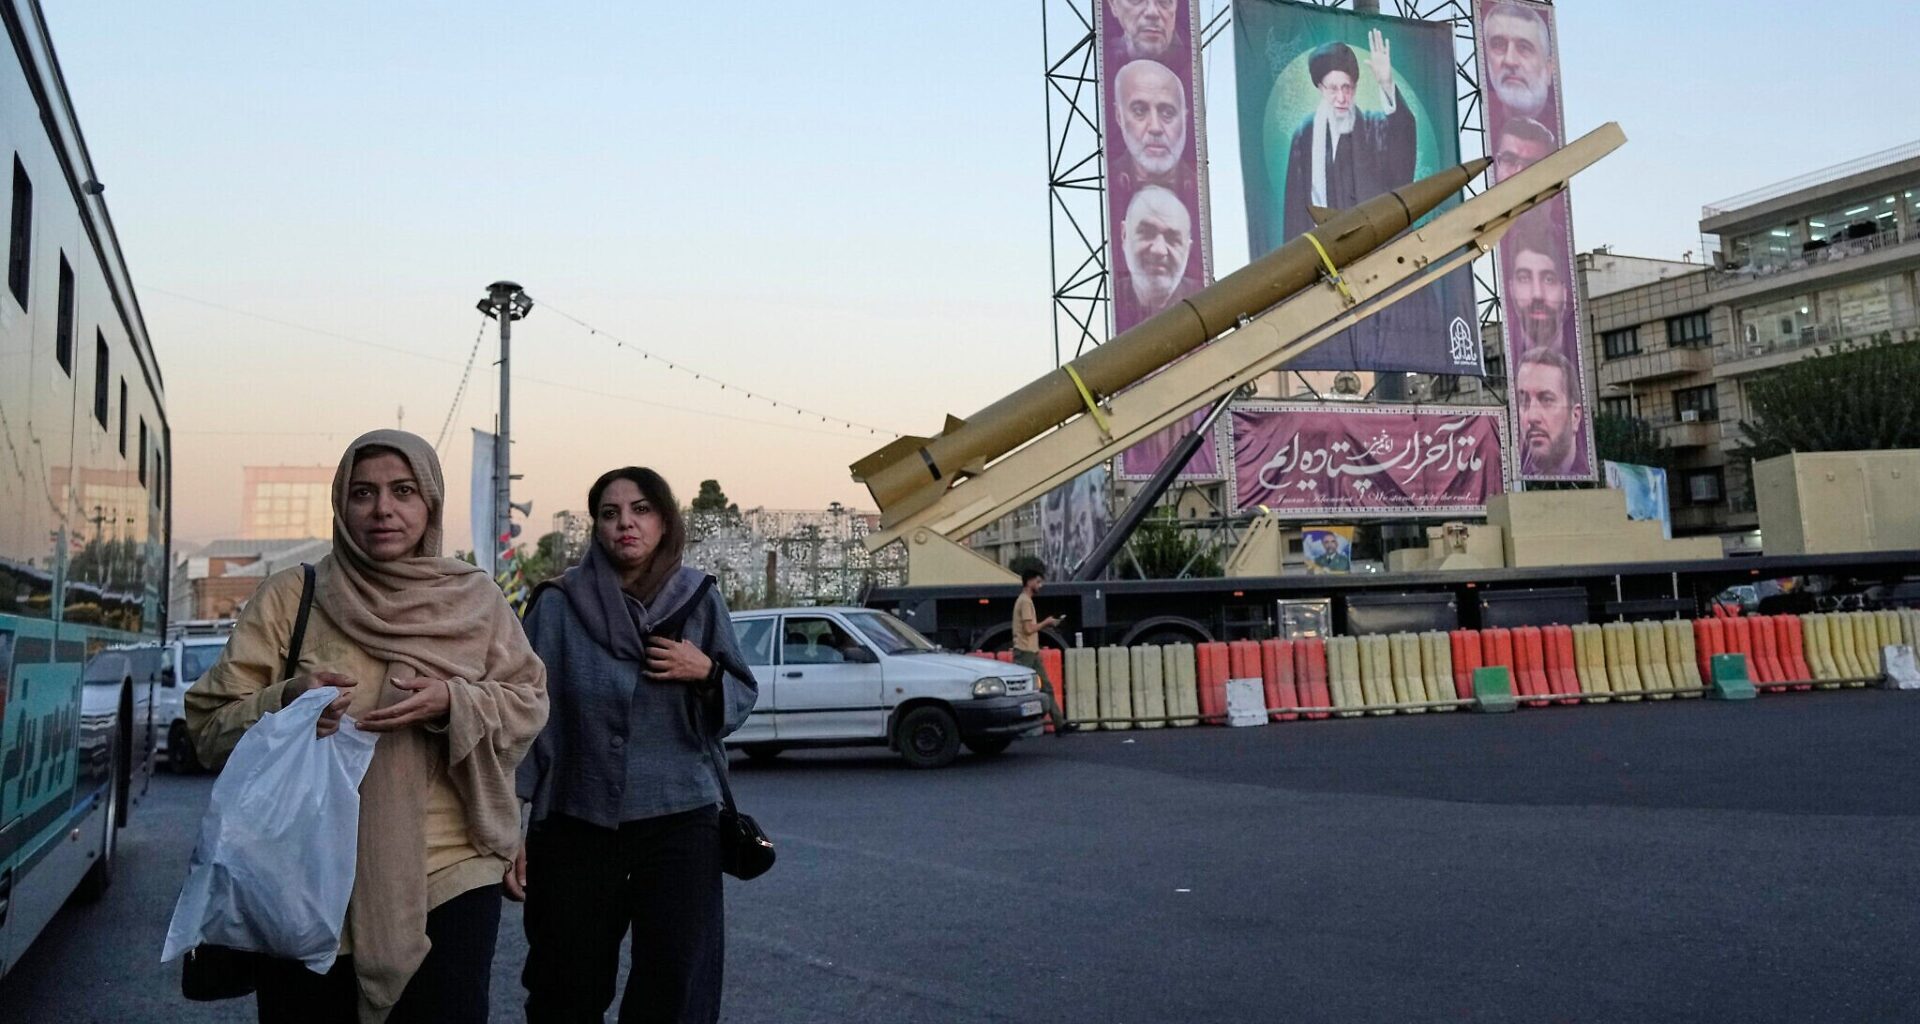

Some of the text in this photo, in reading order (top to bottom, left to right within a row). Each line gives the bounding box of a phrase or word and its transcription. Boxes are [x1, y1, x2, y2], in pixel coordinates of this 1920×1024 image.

[1402, 417, 1467, 485] آخر
[1456, 435, 1476, 472] تا
[1469, 449, 1482, 472] ما
